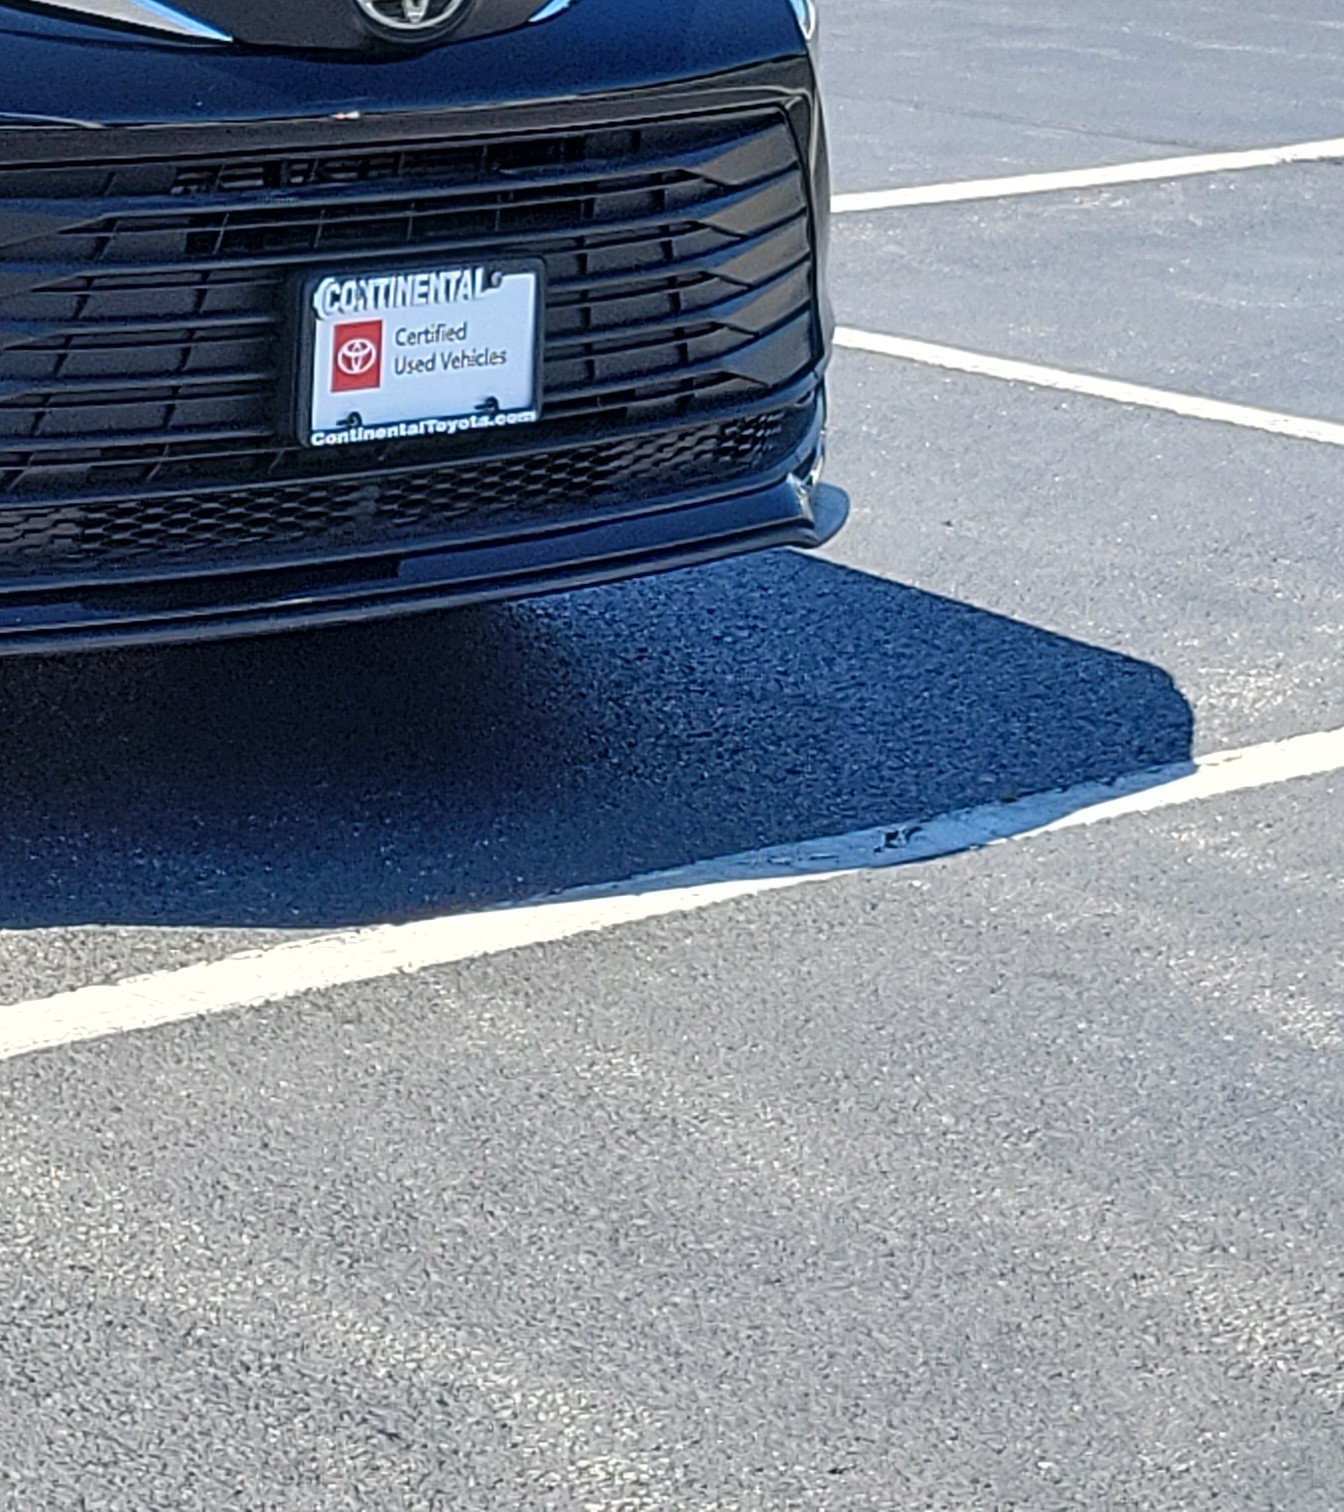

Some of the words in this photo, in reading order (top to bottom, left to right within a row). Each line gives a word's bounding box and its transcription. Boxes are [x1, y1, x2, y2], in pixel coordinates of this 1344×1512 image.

[319, 267, 486, 316] CONTINENTAL
[395, 322, 468, 347] Certified
[394, 352, 436, 375] Used
[441, 347, 507, 370] Vehicles
[310, 410, 537, 447] ContinentalToyota.com
